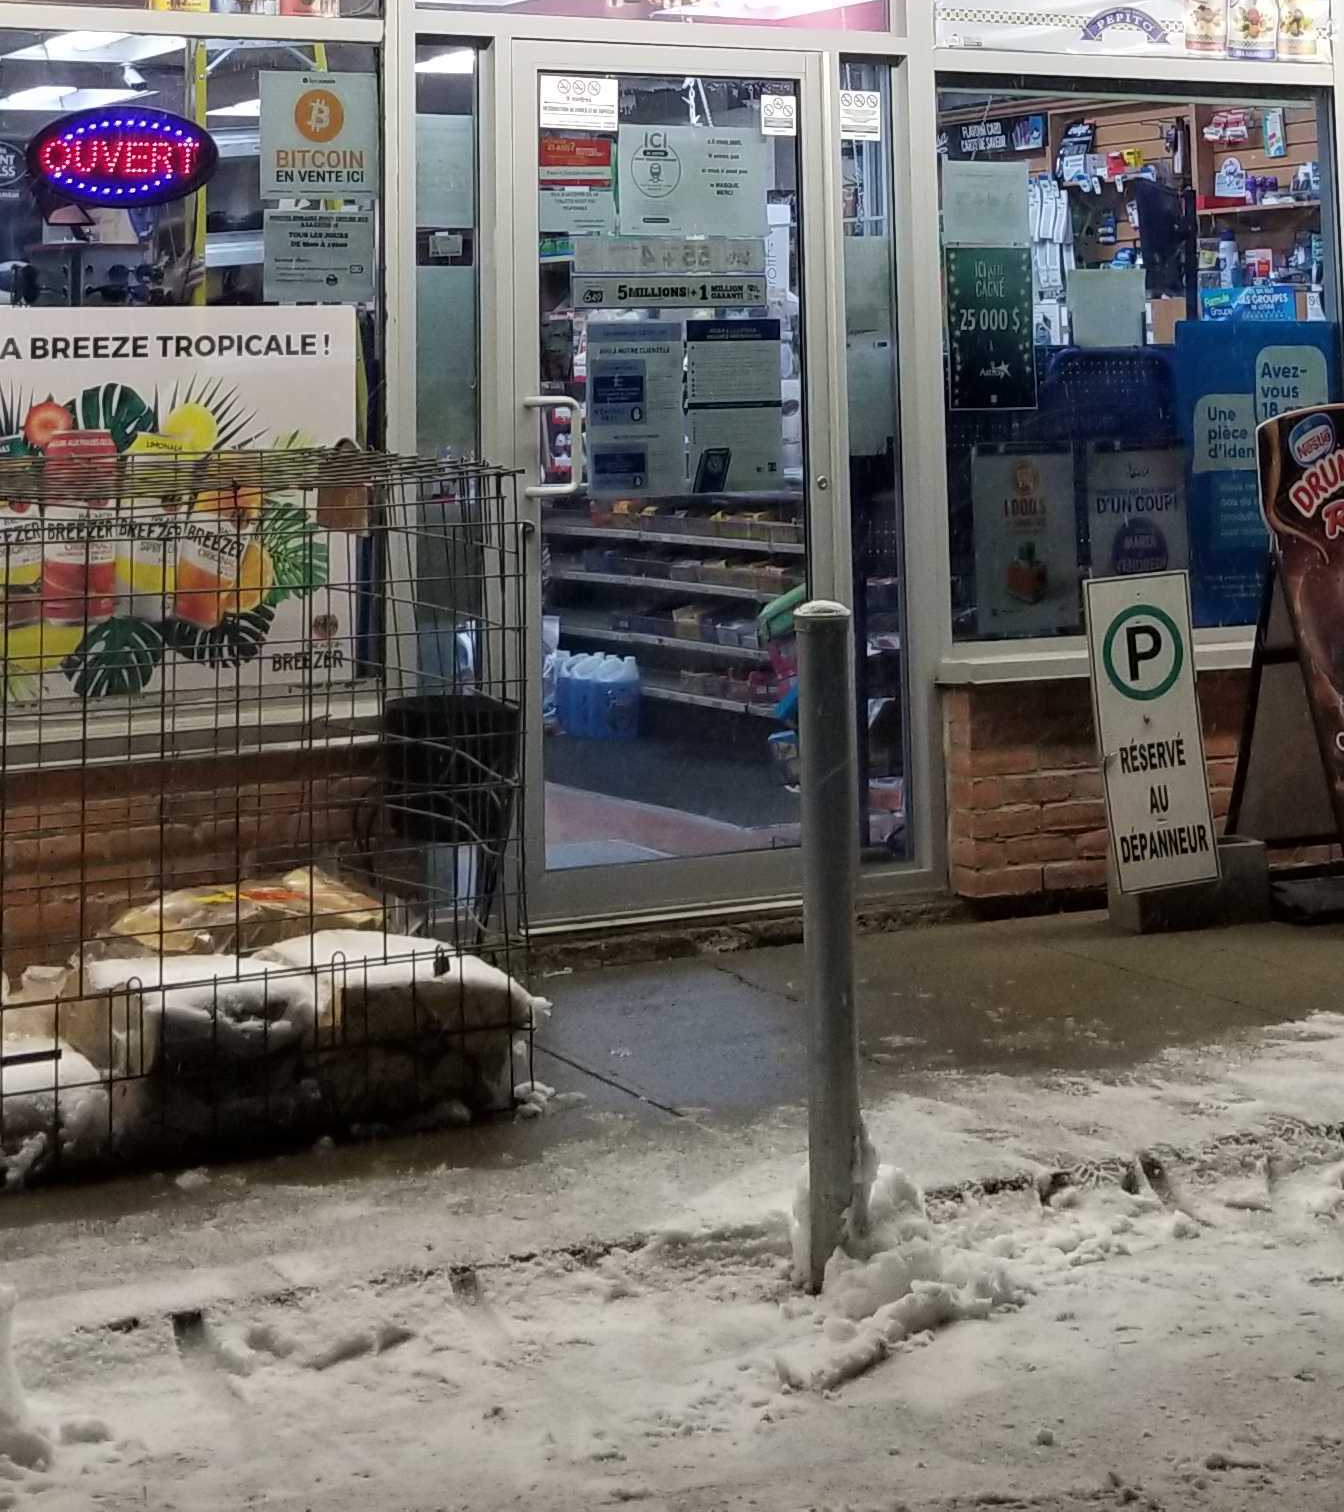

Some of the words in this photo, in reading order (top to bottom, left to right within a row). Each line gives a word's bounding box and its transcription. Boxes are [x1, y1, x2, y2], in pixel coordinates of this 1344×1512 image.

[1096, 13, 1154, 33] PEPITO
[644, 132, 667, 148] ICI
[44, 140, 199, 173] OUVERT
[276, 150, 363, 169] BITCOIN
[276, 170, 294, 183] EN
[298, 170, 343, 183] VENTE
[346, 170, 364, 183] ICI
[617, 285, 628, 300] 5
[628, 286, 687, 298] MILLIONS
[699, 285, 709, 300] 1
[959, 308, 976, 331] 25
[979, 308, 1008, 331] 000
[30, 335, 148, 359] BREEZE
[156, 334, 317, 357] TROPICALE
[1261, 363, 1307, 378] Avez-
[1261, 385, 1299, 399] vous
[1208, 407, 1235, 421] Une
[1263, 402, 1277, 417] 18
[1208, 425, 1248, 445] pièce
[1097, 496, 1132, 514] D'UN
[47, 520, 113, 540] BREEZER
[119, 519, 182, 541] BREEZER
[272, 650, 344, 672] BREEZER
[1126, 625, 1162, 681] P
[1119, 731, 1186, 775] RÉSERVÉ
[1150, 784, 1169, 814] AU
[1120, 824, 1209, 864] DÉPANNEUR
